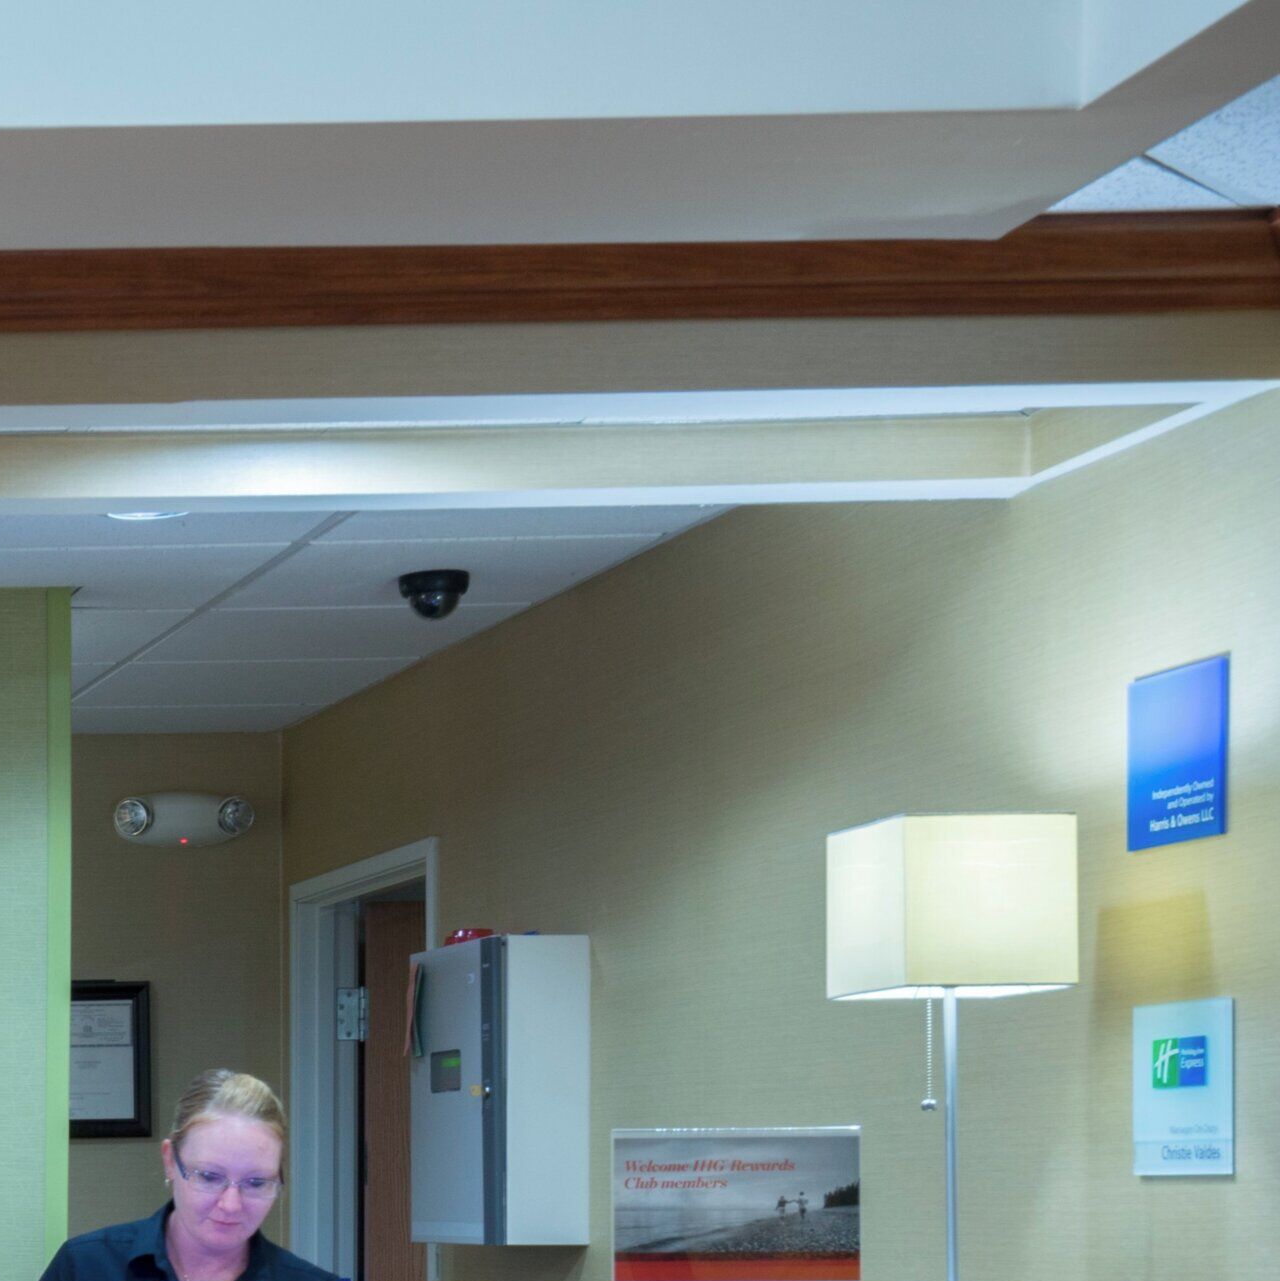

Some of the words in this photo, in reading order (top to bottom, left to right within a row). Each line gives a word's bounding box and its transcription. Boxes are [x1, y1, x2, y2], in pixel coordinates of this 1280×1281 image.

[1152, 783, 1192, 800] Independently
[1200, 806, 1215, 822] LLC
[1180, 1057, 1204, 1069] Express
[624, 1160, 690, 1173] Welcome
[692, 1159, 724, 1172] IHG
[730, 1158, 796, 1172] Rewards
[624, 1177, 658, 1189] Club
[660, 1176, 729, 1189] members
